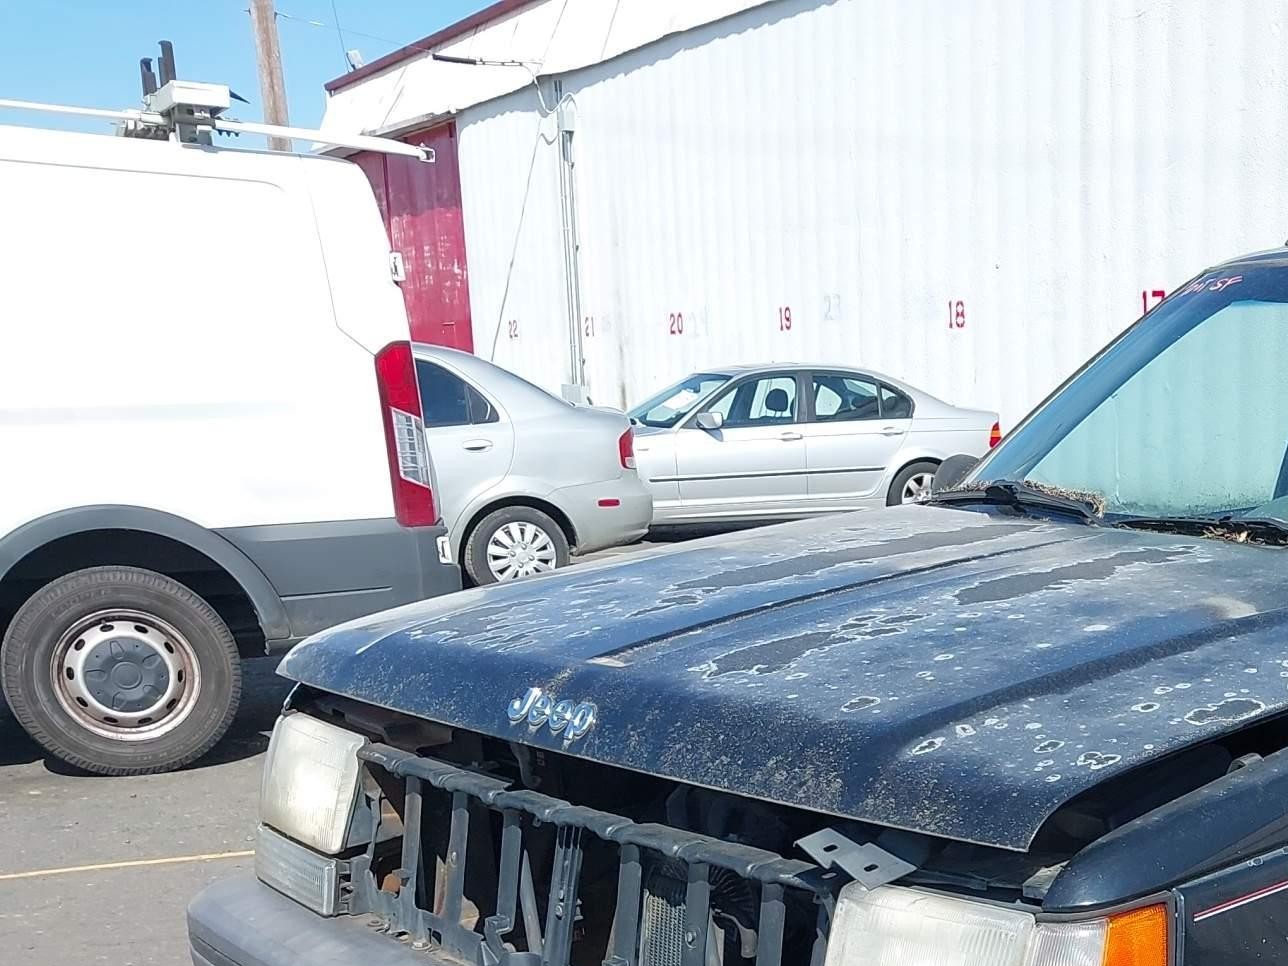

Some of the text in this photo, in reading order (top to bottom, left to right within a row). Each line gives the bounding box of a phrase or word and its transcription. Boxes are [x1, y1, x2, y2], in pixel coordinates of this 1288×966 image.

[669, 312, 684, 335] 20
[779, 306, 792, 331] 19
[948, 300, 966, 328] 18
[508, 320, 519, 339] 22
[585, 318, 595, 337] 21
[507, 687, 597, 741] Jeep
